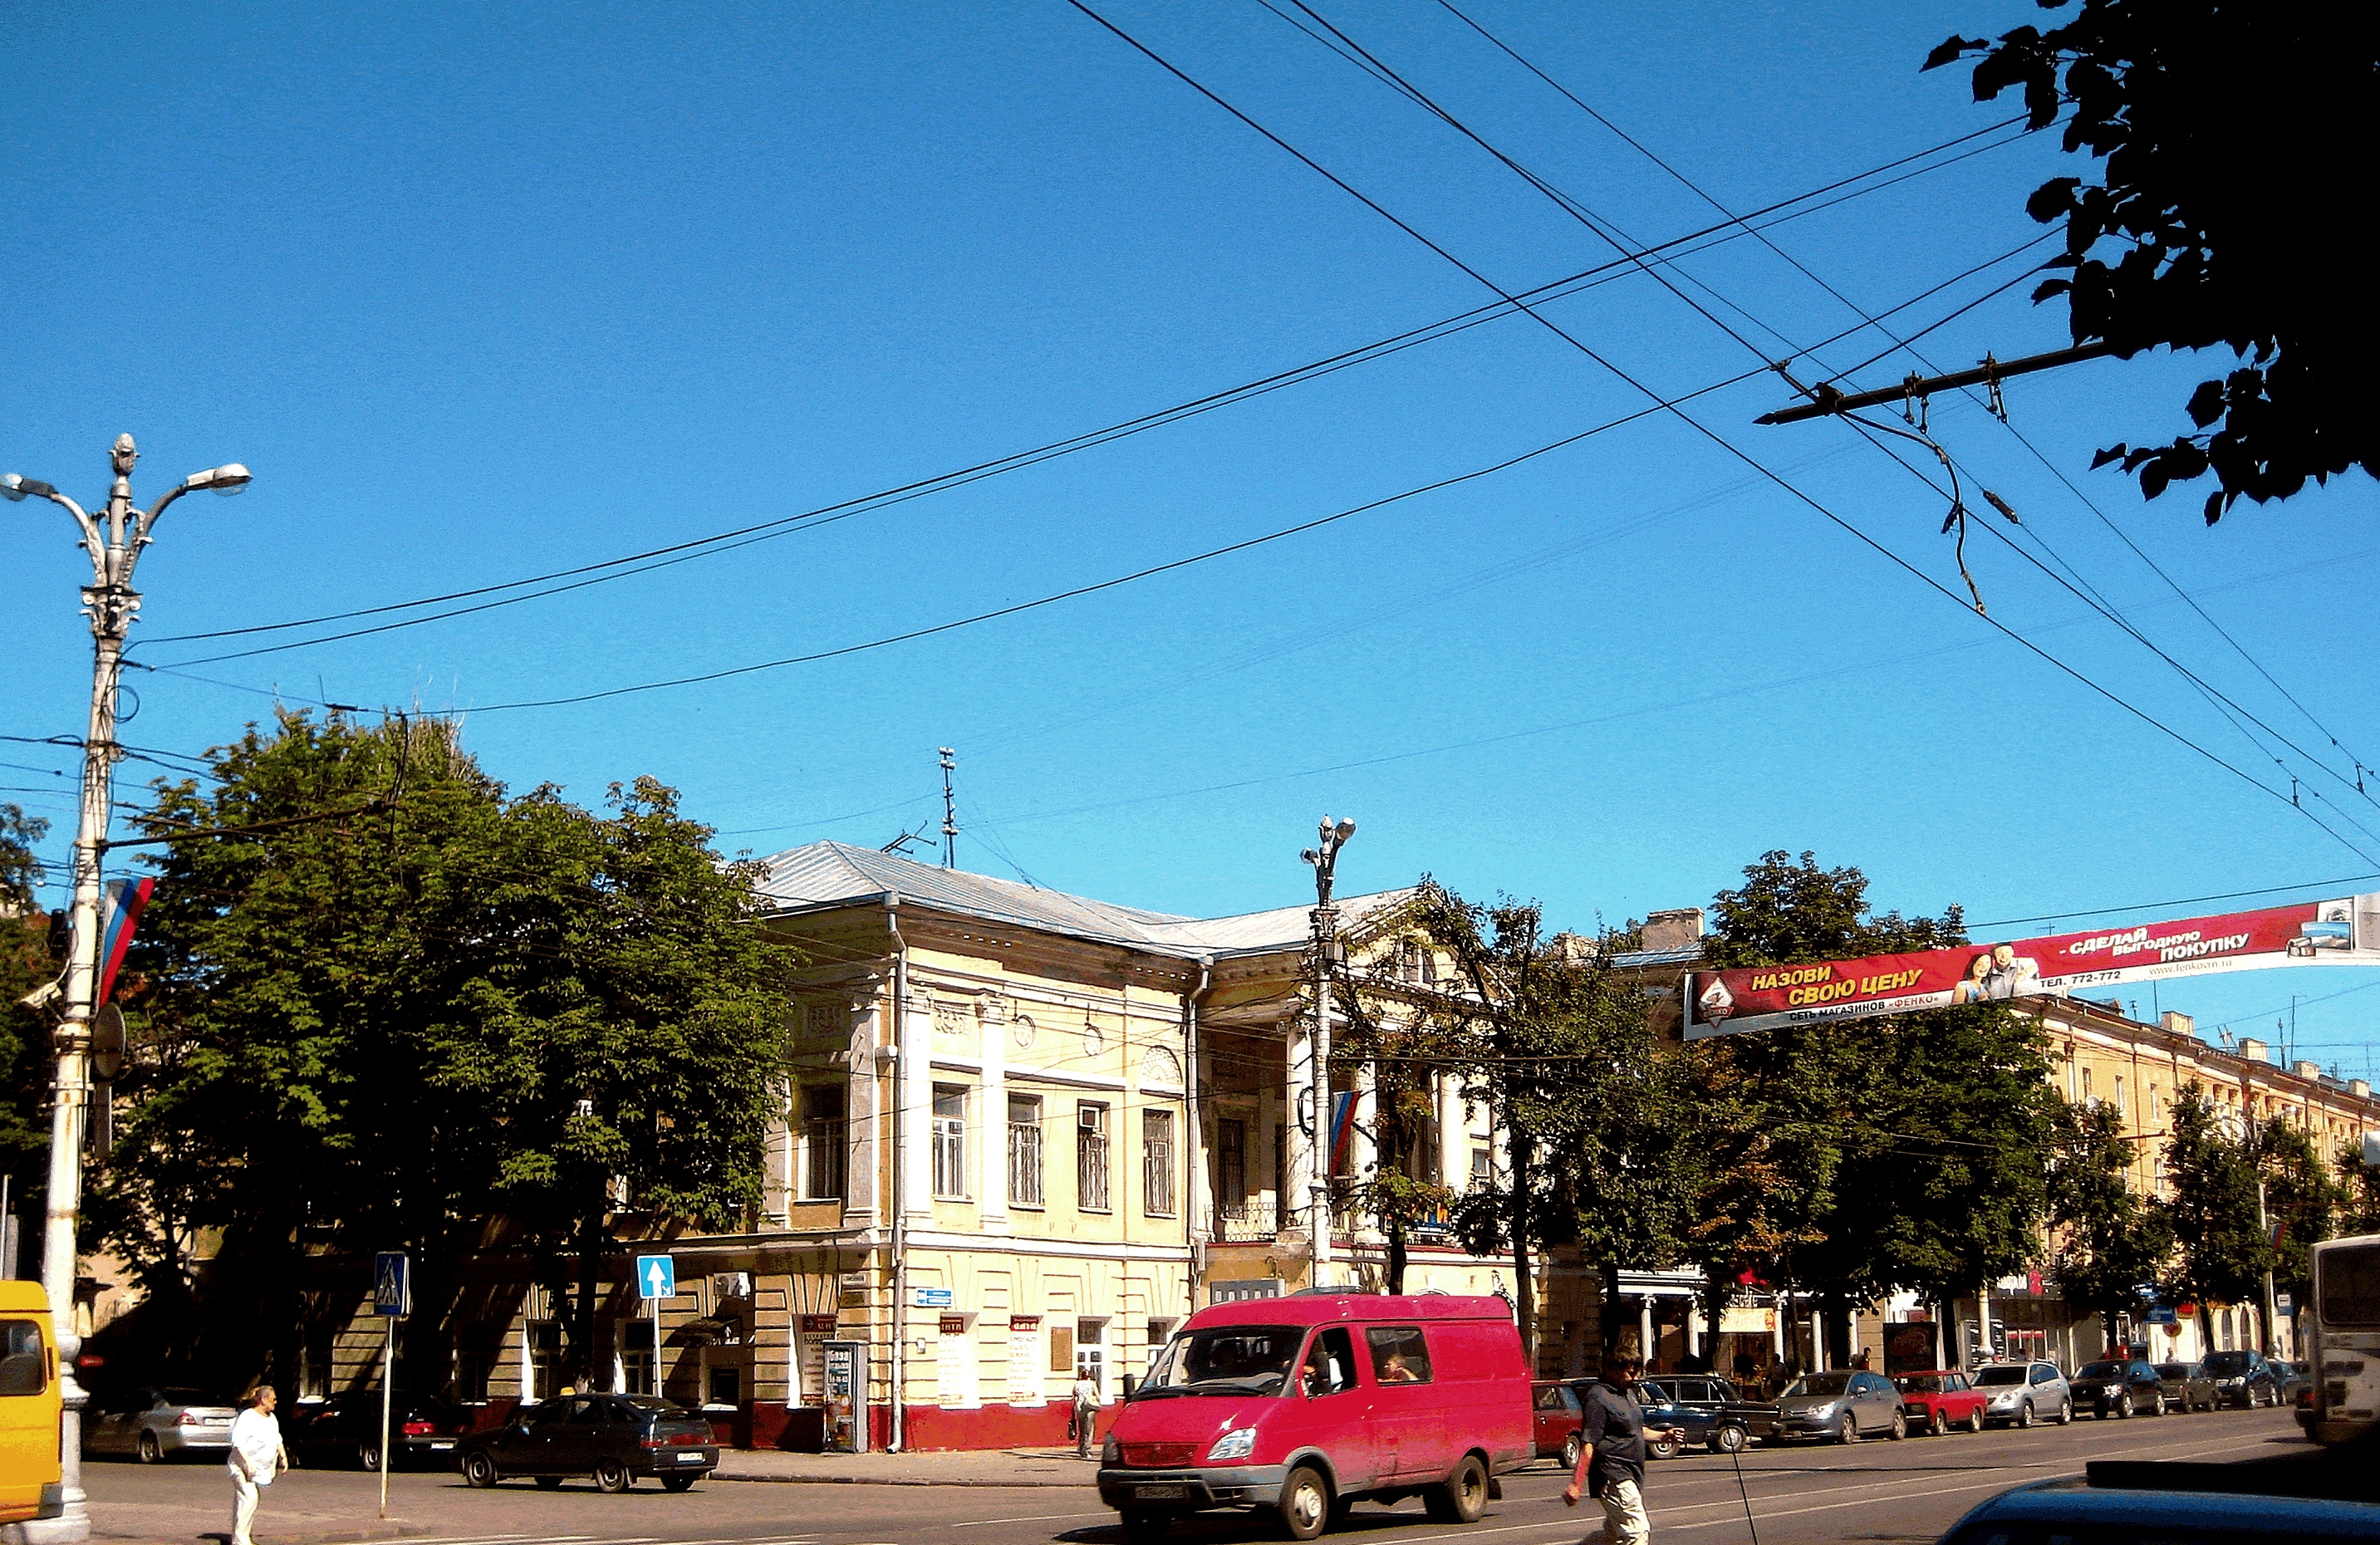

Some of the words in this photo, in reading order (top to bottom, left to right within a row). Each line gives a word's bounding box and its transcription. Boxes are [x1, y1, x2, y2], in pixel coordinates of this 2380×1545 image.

[2069, 928, 2147, 954] СДЕЛАЙ
[2112, 931, 2201, 957] ВЫГОДНУЮ
[2161, 934, 2250, 962] ПОКУПКУ
[1752, 966, 1832, 990] НАЗОВИ
[1789, 979, 1857, 1006] СВОЮ
[1861, 969, 1923, 995] ЦЕНУ
[2040, 979, 2067, 988] ТЕЛ.
[2073, 971, 2121, 984] 772-772
[1789, 1011, 1817, 1021] СЕТЬ
[1818, 1002, 1886, 1018] МАГАЗИНОВ
